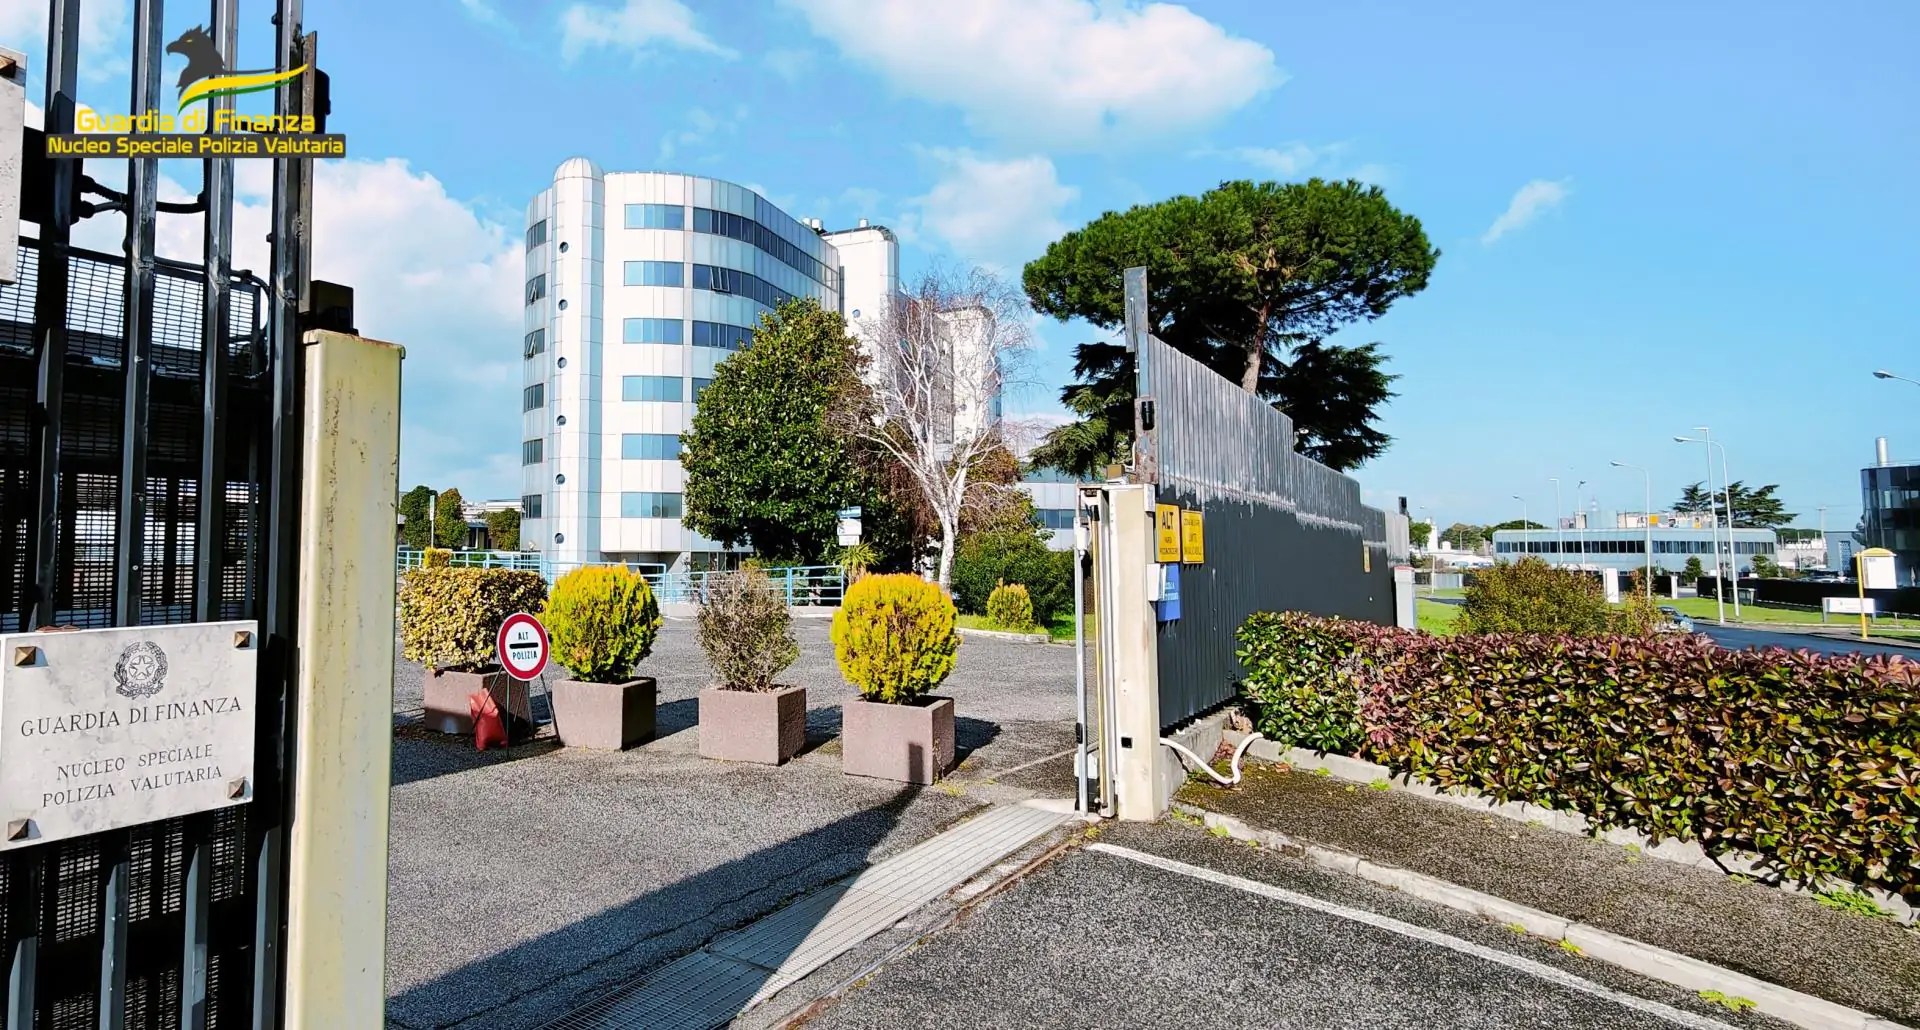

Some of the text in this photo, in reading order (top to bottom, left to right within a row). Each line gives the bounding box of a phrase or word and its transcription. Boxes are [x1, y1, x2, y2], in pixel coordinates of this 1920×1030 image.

[1162, 511, 1174, 530] ALT
[518, 632, 528, 640] ALT
[512, 650, 537, 660] POLIZIA
[21, 696, 242, 737] GUARDIA DI FINANZA
[57, 744, 214, 781] NUCLEO SPECIALE
[42, 766, 223, 808] POLIZIA VALUTARIA
